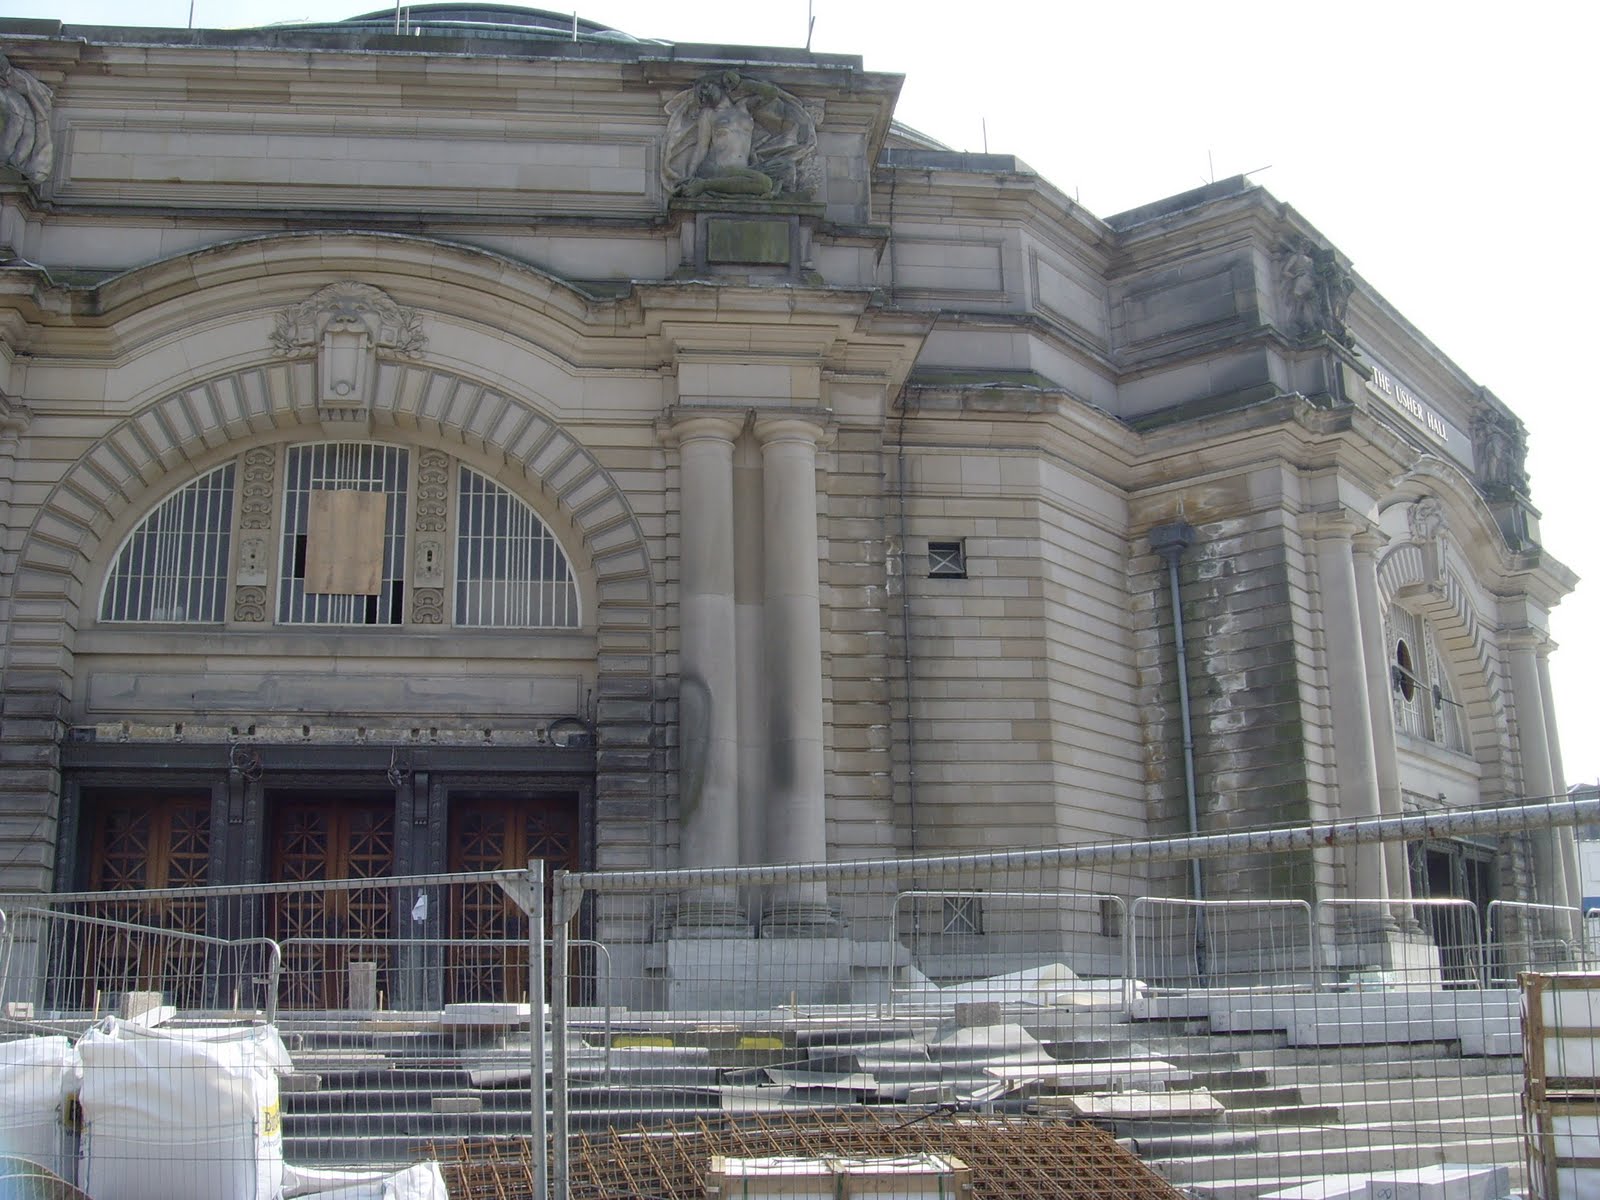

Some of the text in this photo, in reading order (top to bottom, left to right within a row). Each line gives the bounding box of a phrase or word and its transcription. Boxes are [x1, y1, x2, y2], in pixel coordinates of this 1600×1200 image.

[1371, 366, 1449, 442] THE USHER HALL
